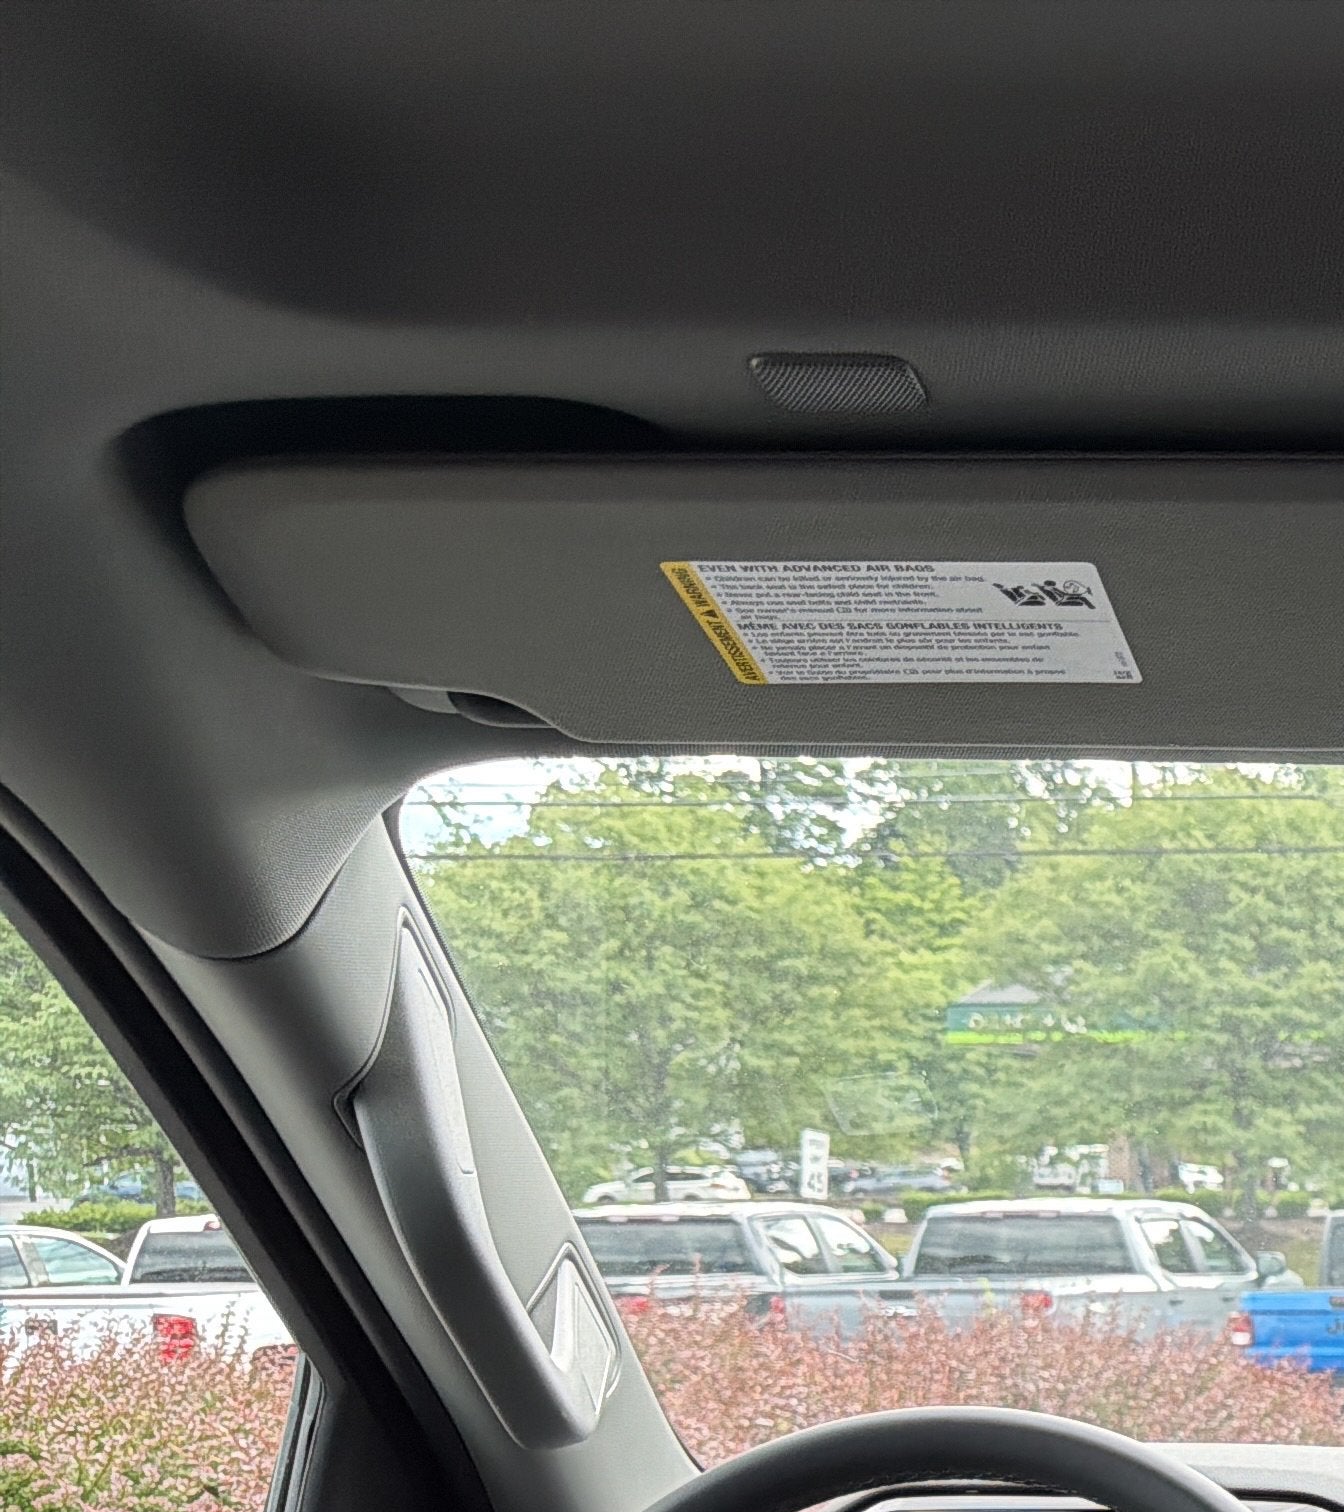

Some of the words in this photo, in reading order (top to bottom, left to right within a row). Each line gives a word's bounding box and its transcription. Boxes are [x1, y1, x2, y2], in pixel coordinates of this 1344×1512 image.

[742, 565, 778, 573] WITH
[782, 565, 861, 573] ADVANCED
[865, 564, 891, 573] AIR
[895, 564, 935, 573] BAGS
